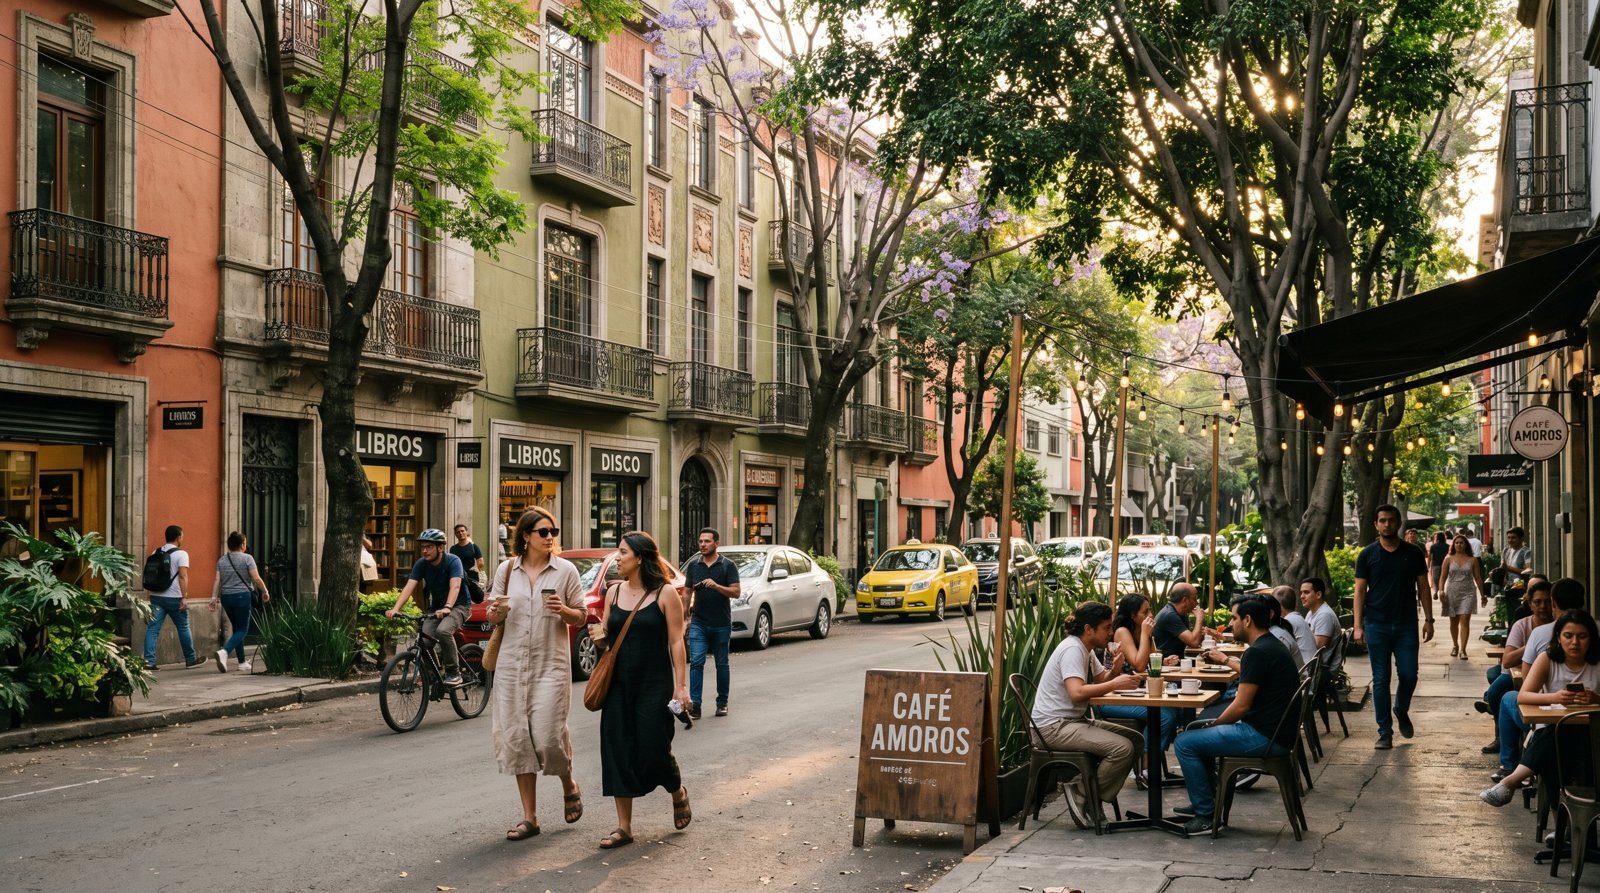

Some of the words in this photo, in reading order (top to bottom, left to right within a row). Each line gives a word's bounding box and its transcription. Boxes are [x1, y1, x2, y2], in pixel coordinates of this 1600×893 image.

[1514, 429, 1563, 442] AMOROS
[1525, 420, 1550, 429] CAFÉ
[356, 430, 423, 457] LIBROS
[508, 443, 562, 467] LIBROS
[601, 453, 641, 474] DISCO
[893, 688, 952, 722] CAFÉ
[870, 723, 970, 756] AMOROS
